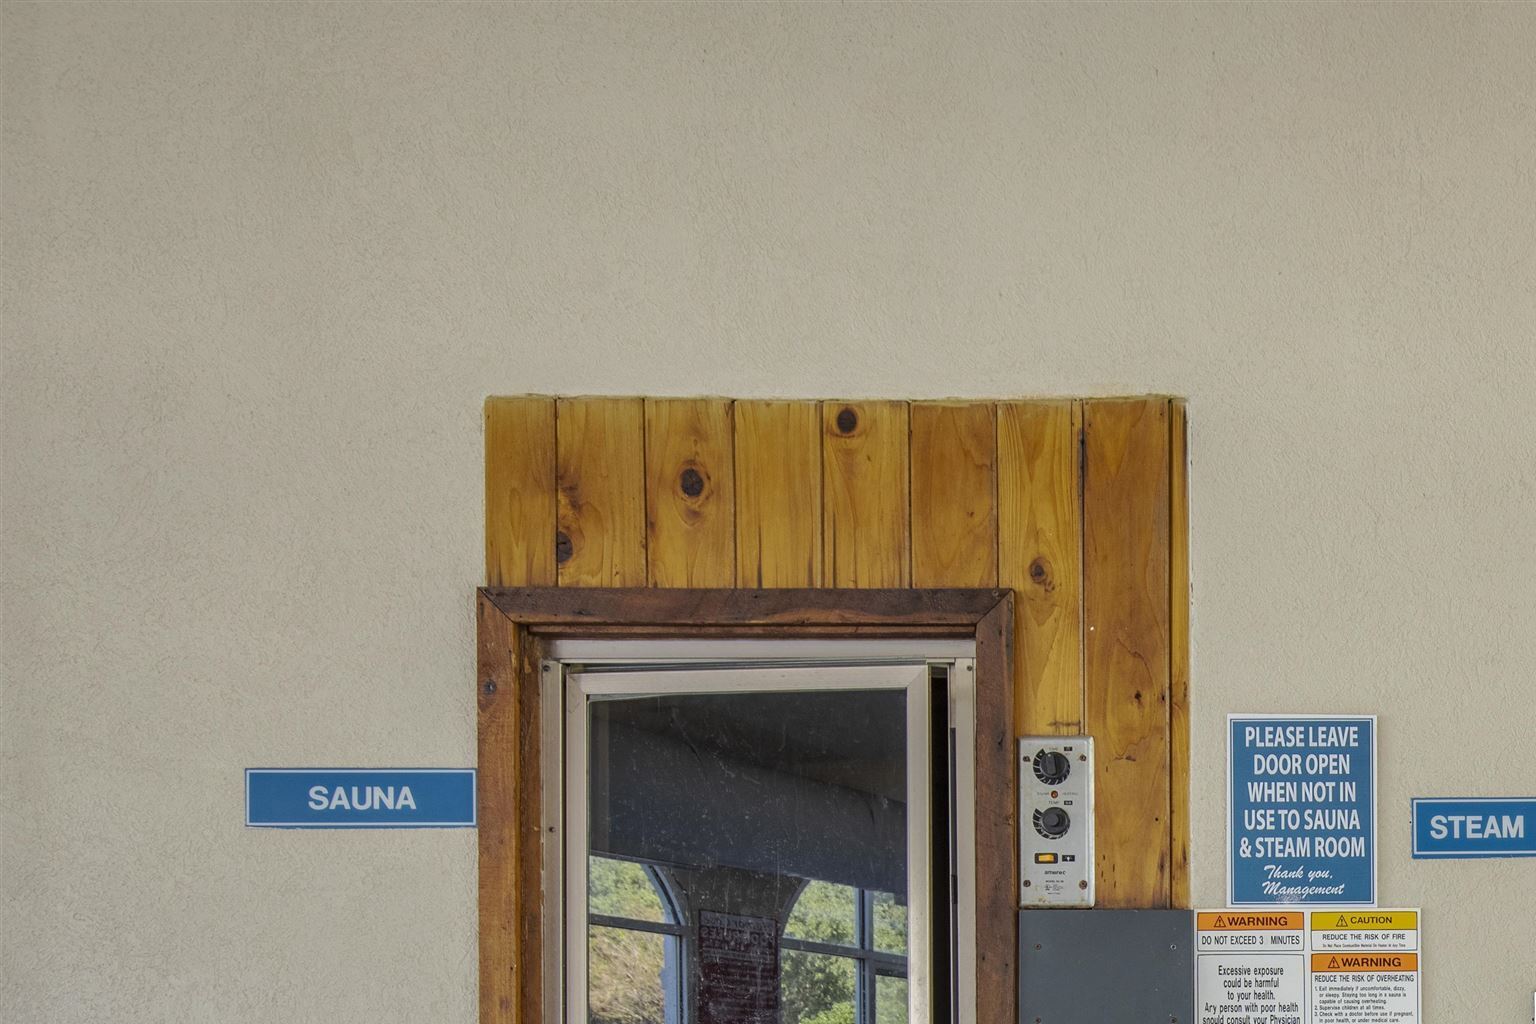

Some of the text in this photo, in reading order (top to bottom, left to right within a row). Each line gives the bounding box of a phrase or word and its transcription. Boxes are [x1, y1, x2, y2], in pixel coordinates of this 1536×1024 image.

[1245, 726, 1359, 748] PLEASE LEAVE
[1253, 754, 1350, 775] DOOR OPEN
[307, 785, 417, 810] SAUNA
[1247, 781, 1356, 803] WHEN NOT IN
[1244, 809, 1361, 831] USE TO SAUNA
[1429, 814, 1525, 840] STEAM
[1239, 836, 1366, 858] & STEAM ROOM
[1263, 864, 1304, 879] Thank
[1261, 881, 1345, 899] Management
[1227, 916, 1288, 926] WARNING
[1350, 916, 1393, 924] CAUTION
[1201, 935, 1212, 945] DO
[1214, 935, 1228, 945] NOT
[1230, 935, 1257, 945] EXCEED
[1270, 935, 1300, 945] MINUTES
[1341, 957, 1402, 967] WARNING
[1218, 964, 1284, 978] Excessive exposure
[1223, 978, 1279, 988] could be harmful
[1314, 974, 1415, 983] REDUCE THE RISK OF OVERHEATING
[1227, 990, 1276, 1002] to your health.
[1219, 1003, 1243, 1014] person
[1244, 1002, 1259, 1012] with
[1260, 1004, 1276, 1014] poor
[1278, 1002, 1299, 1012] health
[1226, 1015, 1251, 1024] consult
